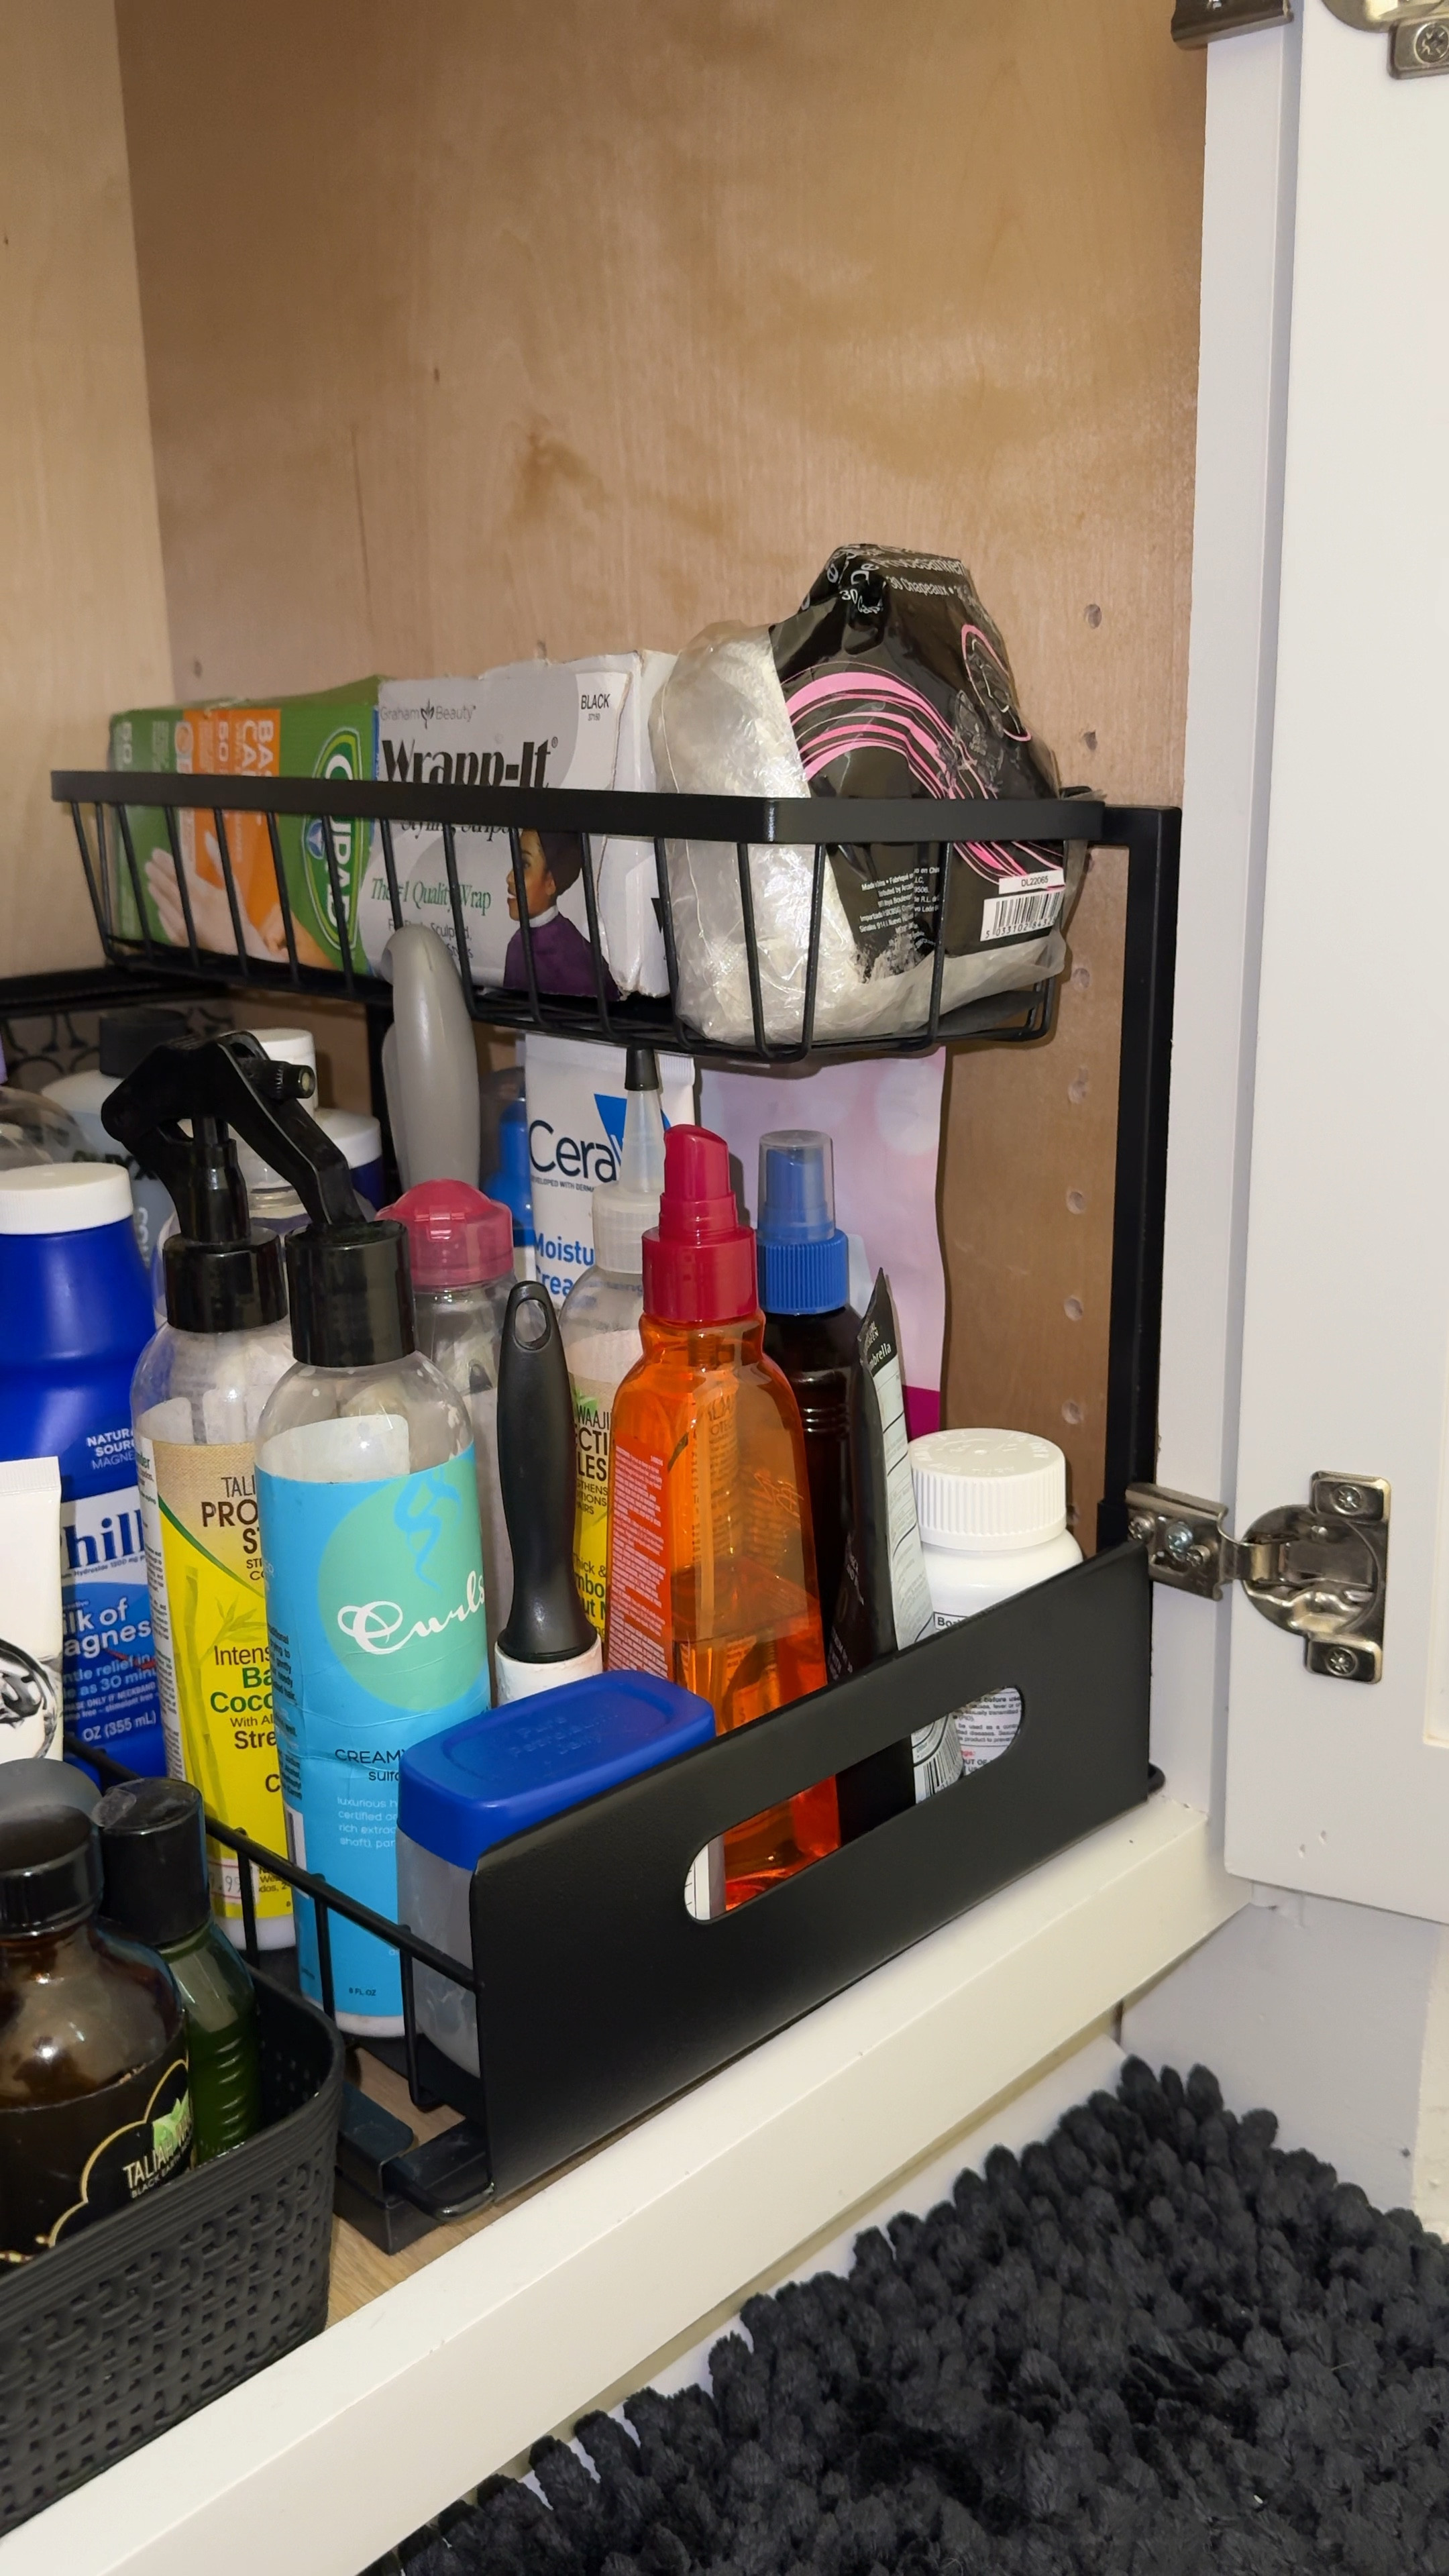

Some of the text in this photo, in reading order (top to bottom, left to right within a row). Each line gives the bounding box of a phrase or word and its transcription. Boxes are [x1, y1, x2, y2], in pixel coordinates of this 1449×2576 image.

[580, 694, 611, 710] BLACK
[380, 705, 474, 722] Graham Beauty
[1020, 875, 1049, 888] DL22065
[575, 1424, 608, 1456] CTI
[91, 1450, 136, 1470] MAGNE
[577, 1451, 608, 1482] LES
[220, 1474, 256, 1498] TALI
[201, 1499, 258, 1527] PRO
[60, 1509, 145, 1570] hill
[242, 1527, 260, 1554] S
[250, 1570, 265, 1581] C
[99, 1597, 128, 1626] of
[80, 1683, 98, 1697] as
[100, 1674, 122, 1691] 30
[82, 1709, 156, 1742] OZ (355 mL)
[229, 1715, 258, 1728] With
[234, 1730, 277, 1750] Stre
[335, 1748, 405, 1764] CREAM
[337, 1796, 386, 1808] luxurious
[338, 1811, 382, 1821] certified
[338, 1823, 358, 1833] rich
